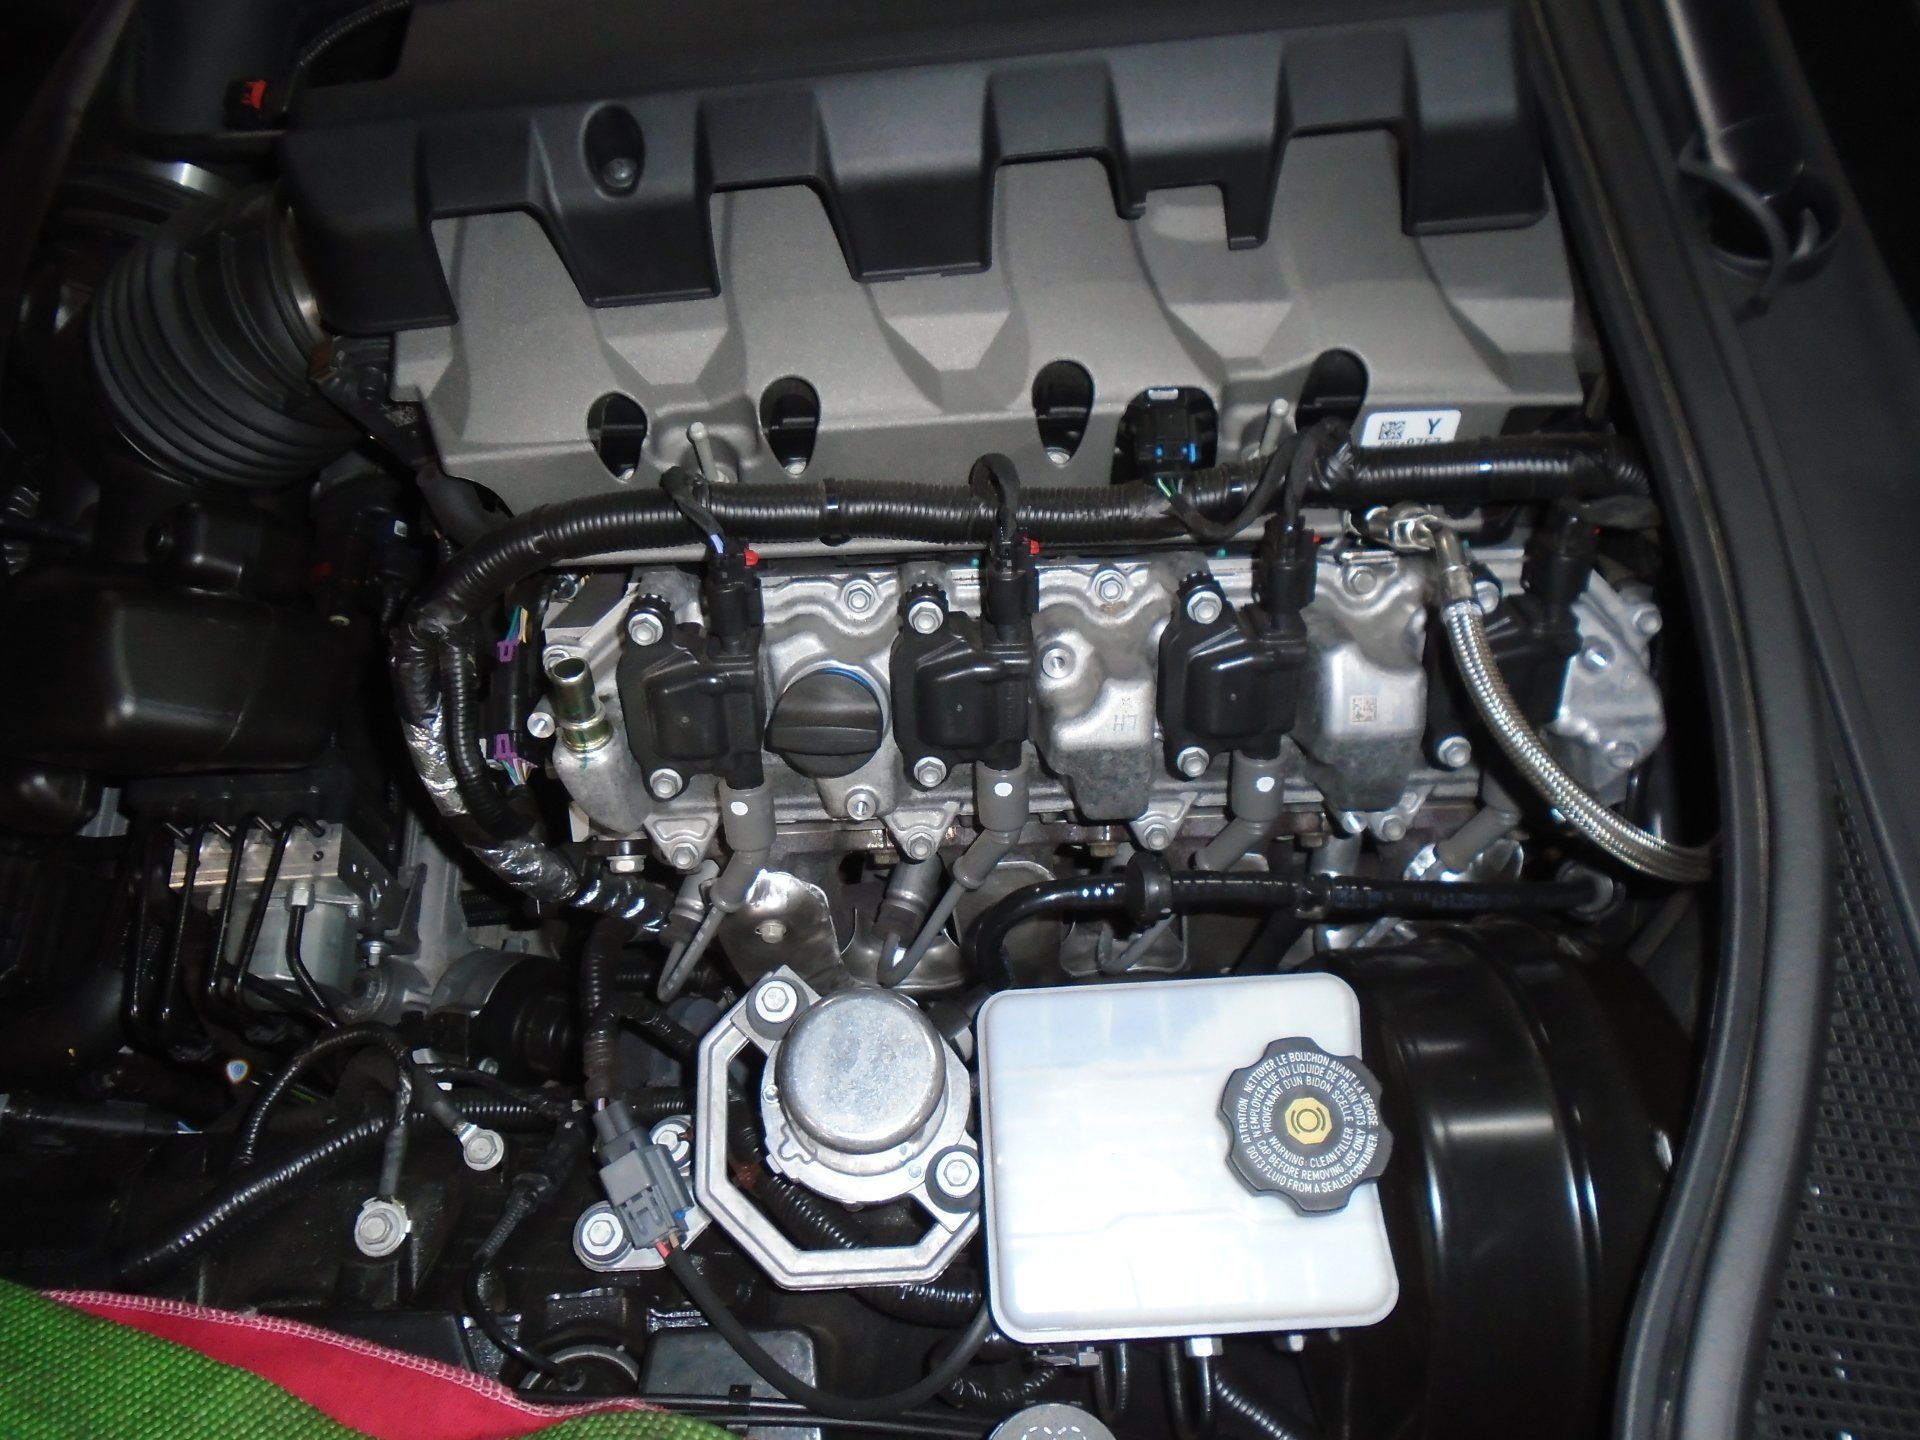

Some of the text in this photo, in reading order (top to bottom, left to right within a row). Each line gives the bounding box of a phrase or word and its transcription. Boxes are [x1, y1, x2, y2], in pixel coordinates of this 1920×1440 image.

[1428, 418, 1441, 434] Y
[1244, 1059, 1276, 1094] NETTOYER
[1276, 1054, 1288, 1066] LE
[1288, 1052, 1330, 1066] BOUCHON
[1330, 1060, 1357, 1081] AVANT
[1353, 1079, 1366, 1094] LA
[1262, 1072, 1279, 1088] QUE
[1278, 1066, 1291, 1078] DU
[1292, 1064, 1325, 1076] LIQUIDE
[1326, 1070, 1338, 1082] DE
[1337, 1079, 1359, 1103] FREIN
[1353, 1104, 1366, 1126] DOT3
[1262, 1084, 1284, 1134] PROVENANT
[1283, 1076, 1303, 1089] D'UN
[1306, 1076, 1333, 1093] BIDON
[1247, 1146, 1265, 1169] DOT3
[1262, 1166, 1287, 1186] FLUID
[1287, 1179, 1312, 1193] FROM
[1314, 1184, 1320, 1194] A
[1322, 1174, 1353, 1193] SEALED
[1257, 1140, 1271, 1155] CAP
[1268, 1154, 1300, 1178] BEFORE
[1343, 1150, 1359, 1166] USE
[1354, 1128, 1366, 1151] ONLY
[1310, 1152, 1338, 1168] CLEAN
[1334, 1128, 1354, 1157] FILLER
